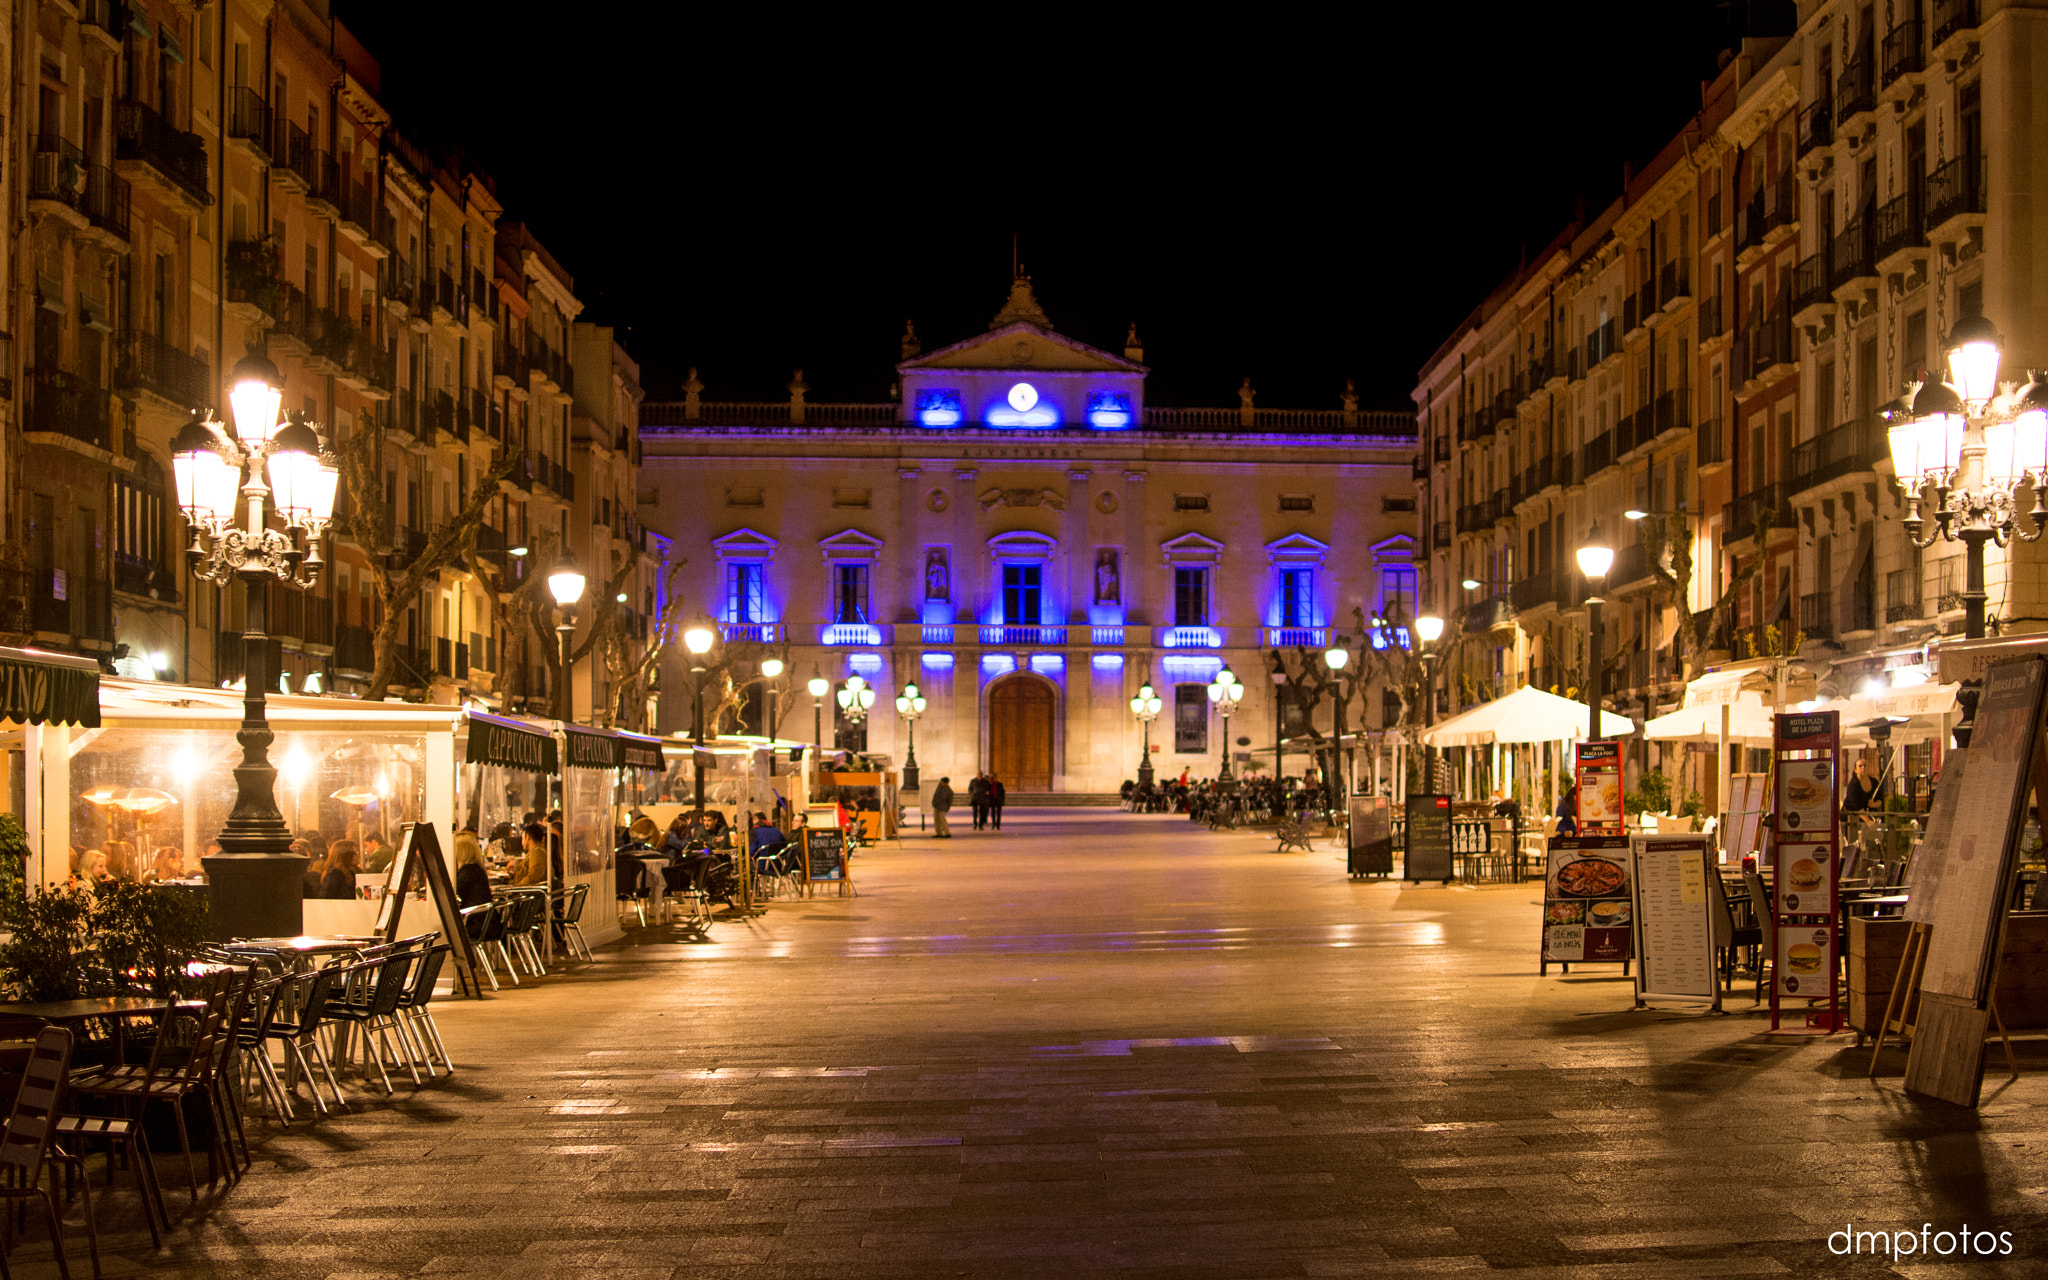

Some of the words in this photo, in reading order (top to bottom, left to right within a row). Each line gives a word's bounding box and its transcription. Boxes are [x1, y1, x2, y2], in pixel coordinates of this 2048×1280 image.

[0, 664, 48, 714] INO
[1789, 718, 1806, 726] HOTEL
[1807, 717, 1825, 725] PLAZA
[1791, 726, 1799, 734] DE
[1808, 725, 1822, 733] FONT
[488, 726, 543, 767] CAPPUCCINO
